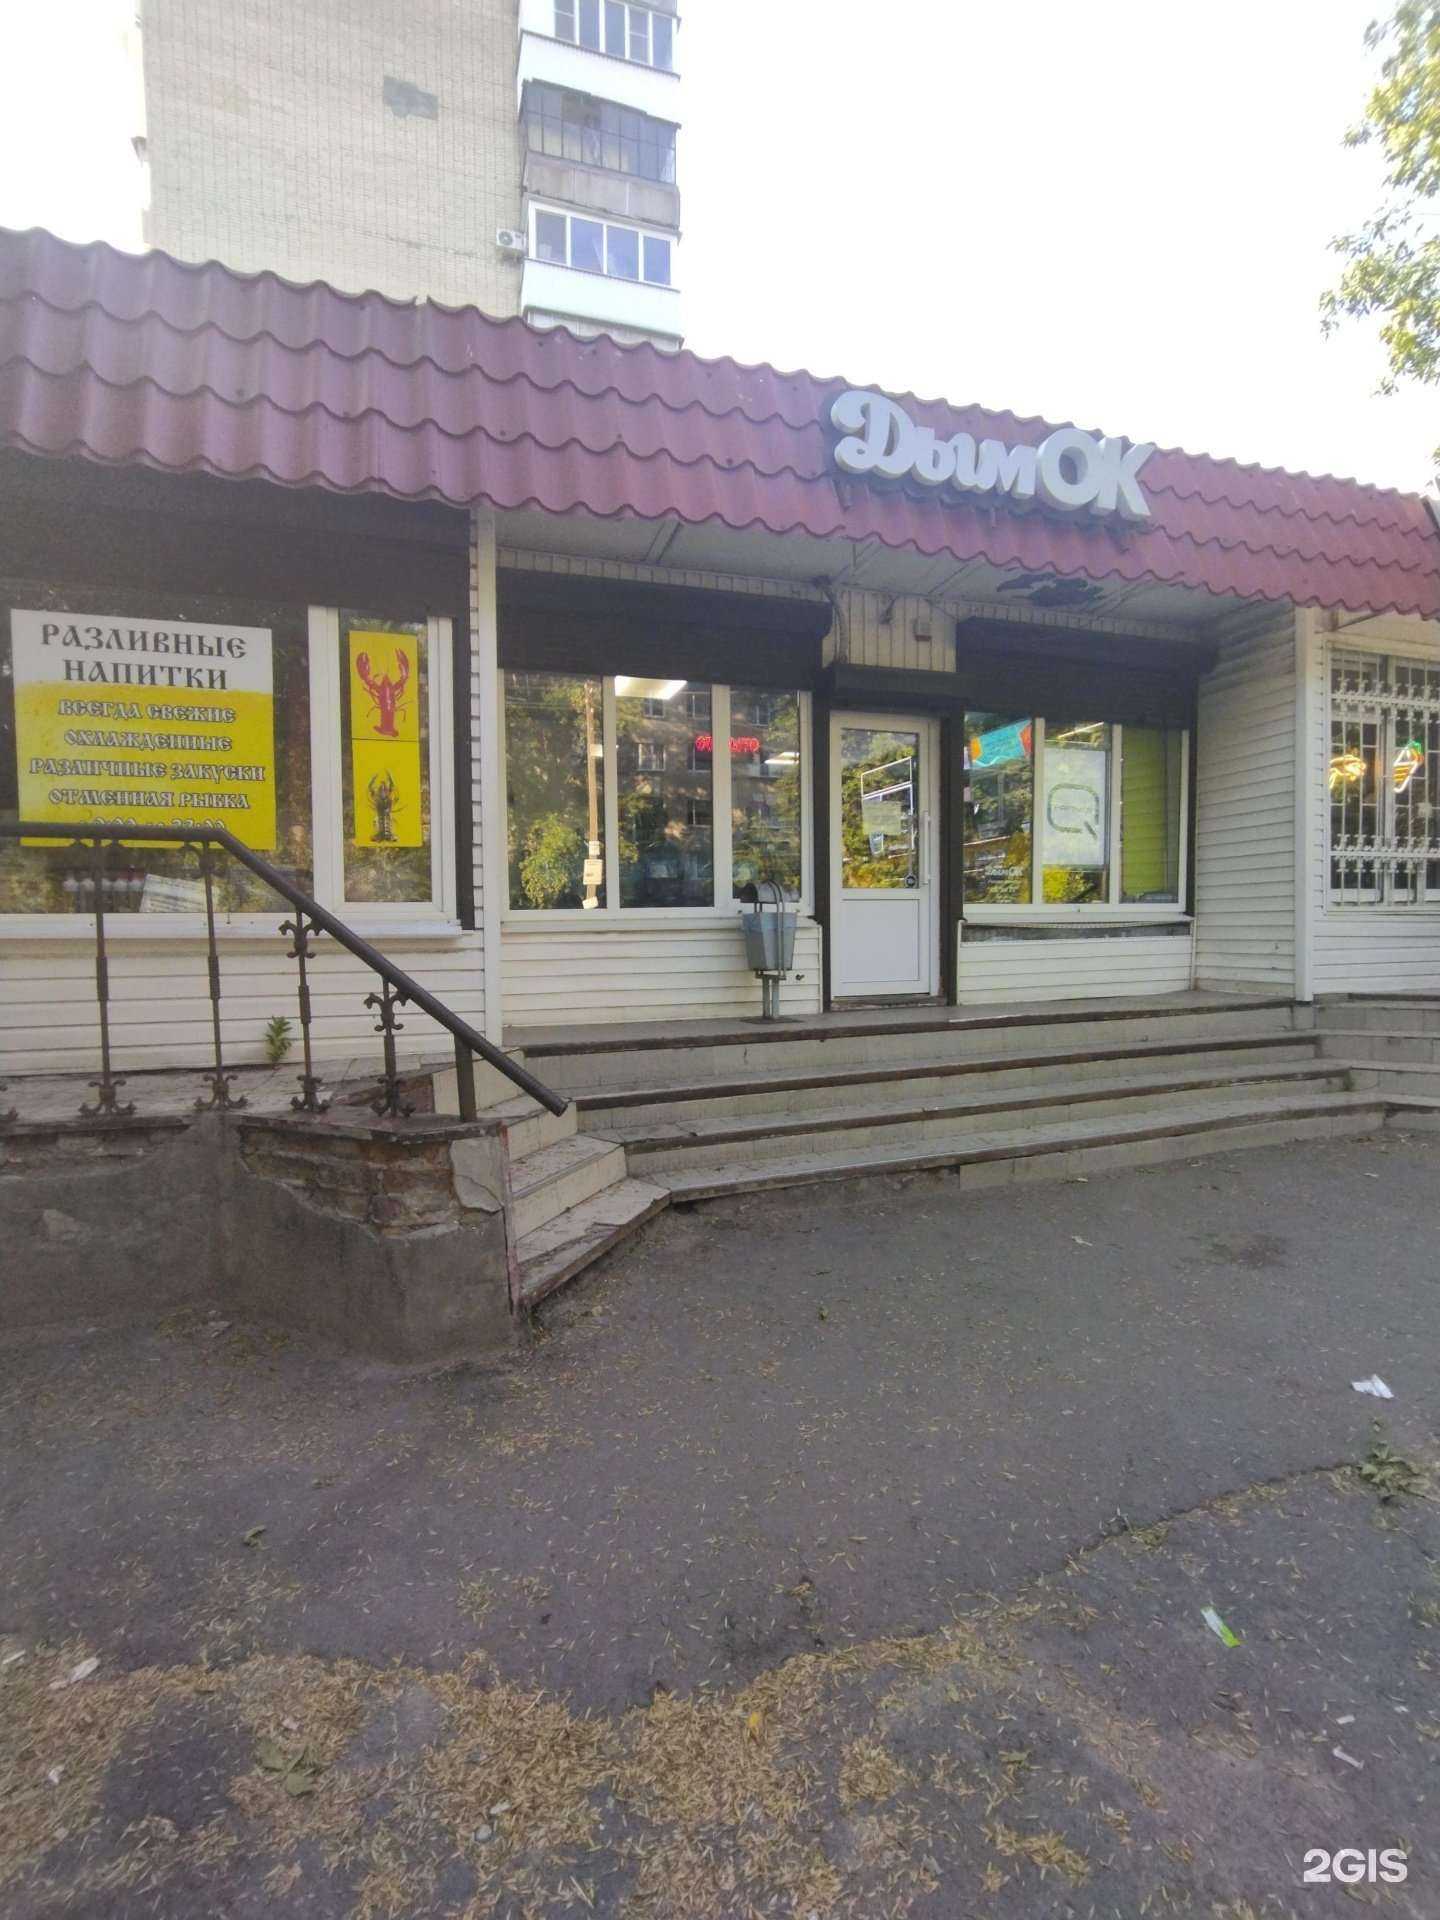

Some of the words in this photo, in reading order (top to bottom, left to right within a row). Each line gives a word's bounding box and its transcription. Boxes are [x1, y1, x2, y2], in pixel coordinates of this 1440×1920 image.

[41, 623, 247, 659] РАЗЛИВНЫЕ
[63, 658, 228, 690] НАПИТКИ
[58, 699, 142, 720] ВСЕГДА
[146, 703, 237, 723] СВЕЖИЕ
[64, 729, 232, 751] ОХЛАЖДЕННЫЕ
[30, 758, 167, 778] РАЗЛИЧНЫЕ
[170, 762, 266, 784] ЗАКУСКИ
[48, 788, 174, 807] ОТМЕННАЯ
[178, 792, 250, 809] РЫБКА
